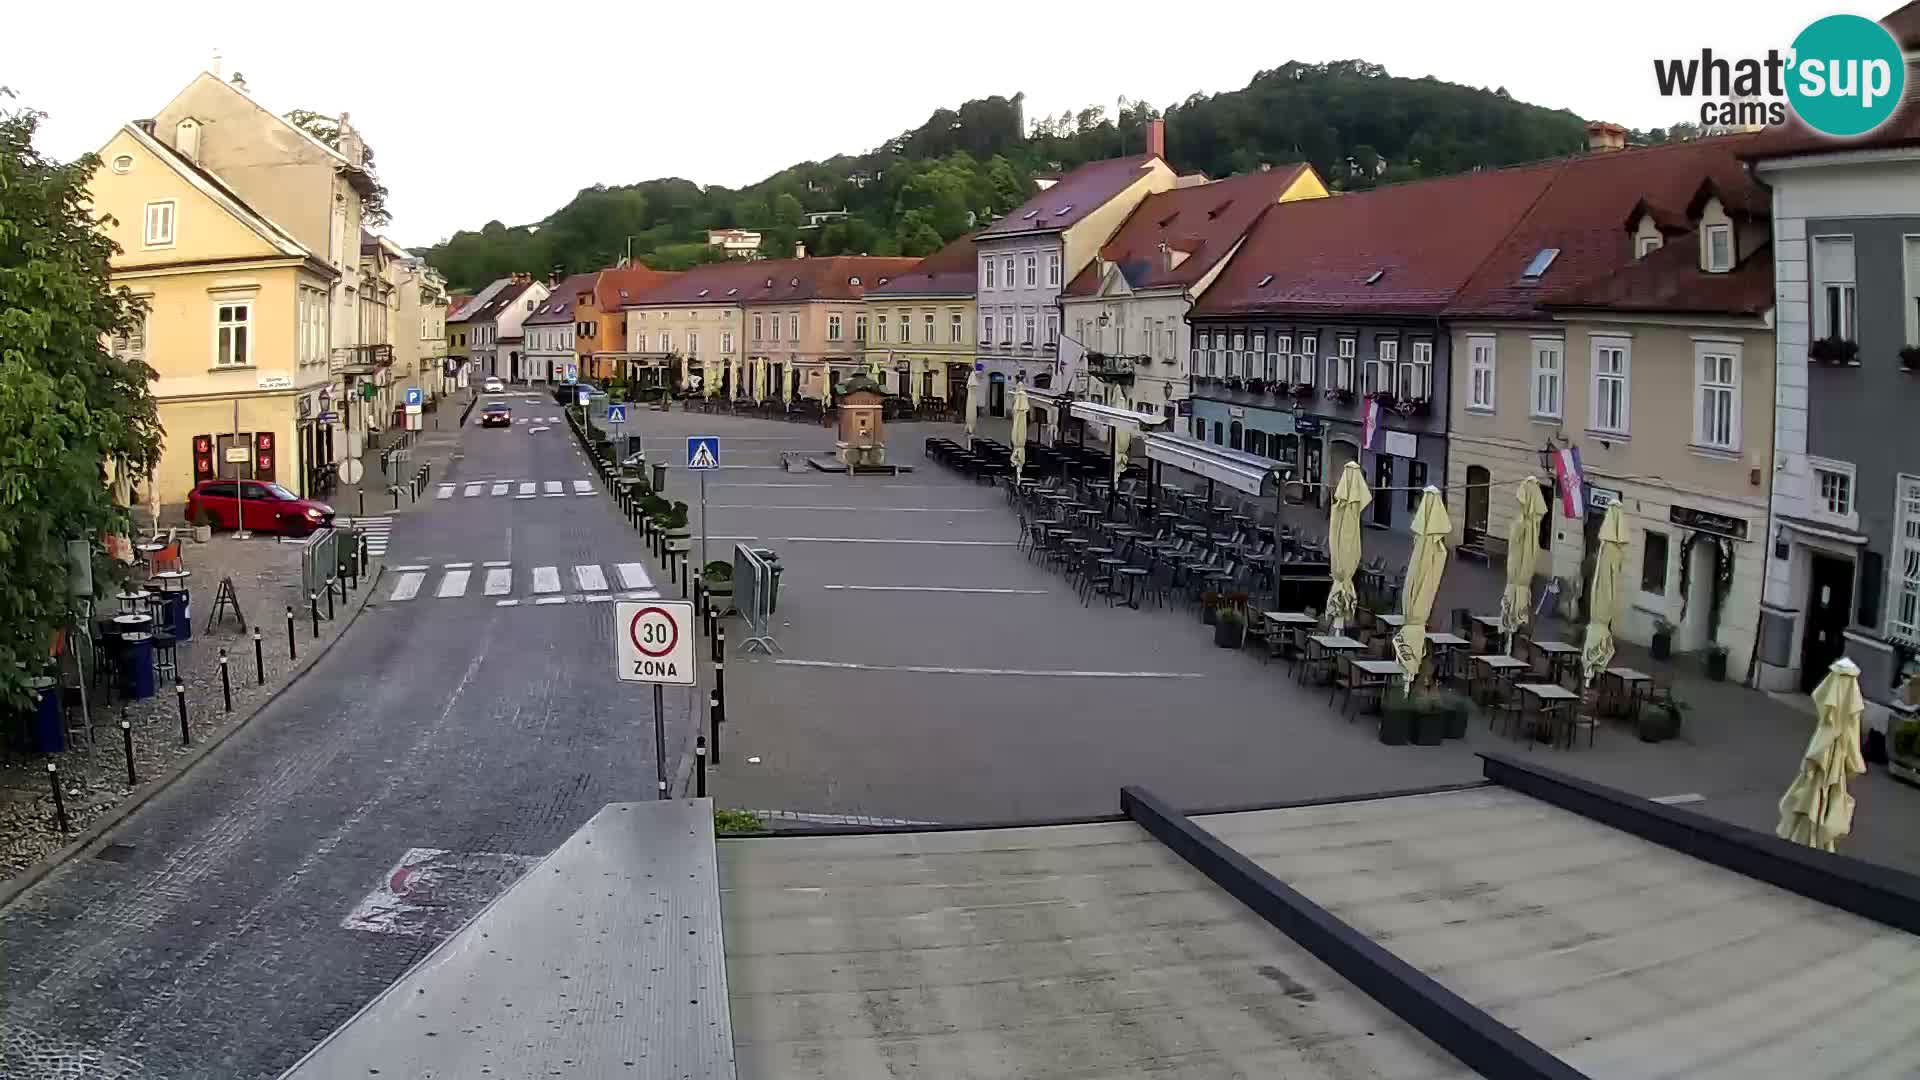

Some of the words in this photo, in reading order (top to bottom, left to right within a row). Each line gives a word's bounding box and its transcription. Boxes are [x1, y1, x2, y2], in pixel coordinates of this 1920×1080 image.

[409, 392, 418, 402] P
[643, 623, 666, 644] 30
[633, 660, 677, 676] ZONA
